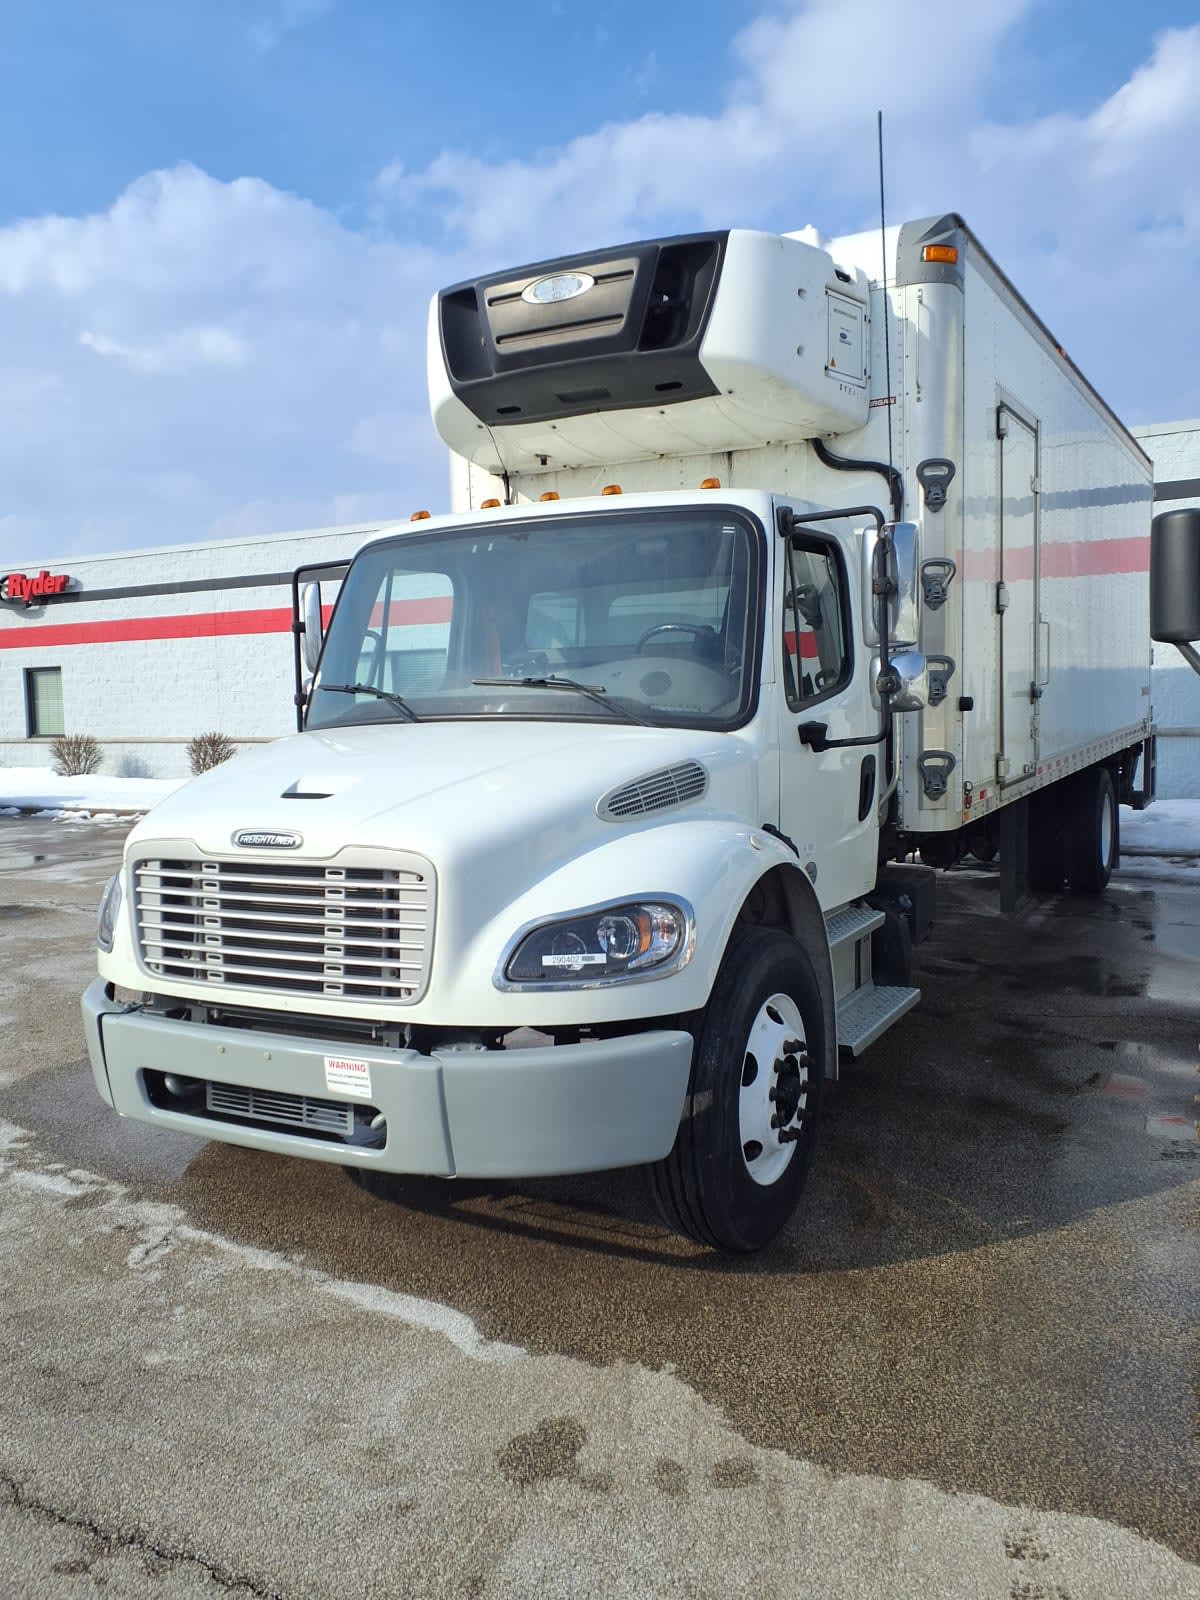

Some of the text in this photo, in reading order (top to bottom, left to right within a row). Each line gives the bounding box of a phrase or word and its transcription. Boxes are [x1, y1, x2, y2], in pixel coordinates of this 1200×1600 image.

[8, 570, 68, 602] Ryder
[239, 834, 295, 846] FREIGHTLINER
[327, 1060, 367, 1072] WARNING
